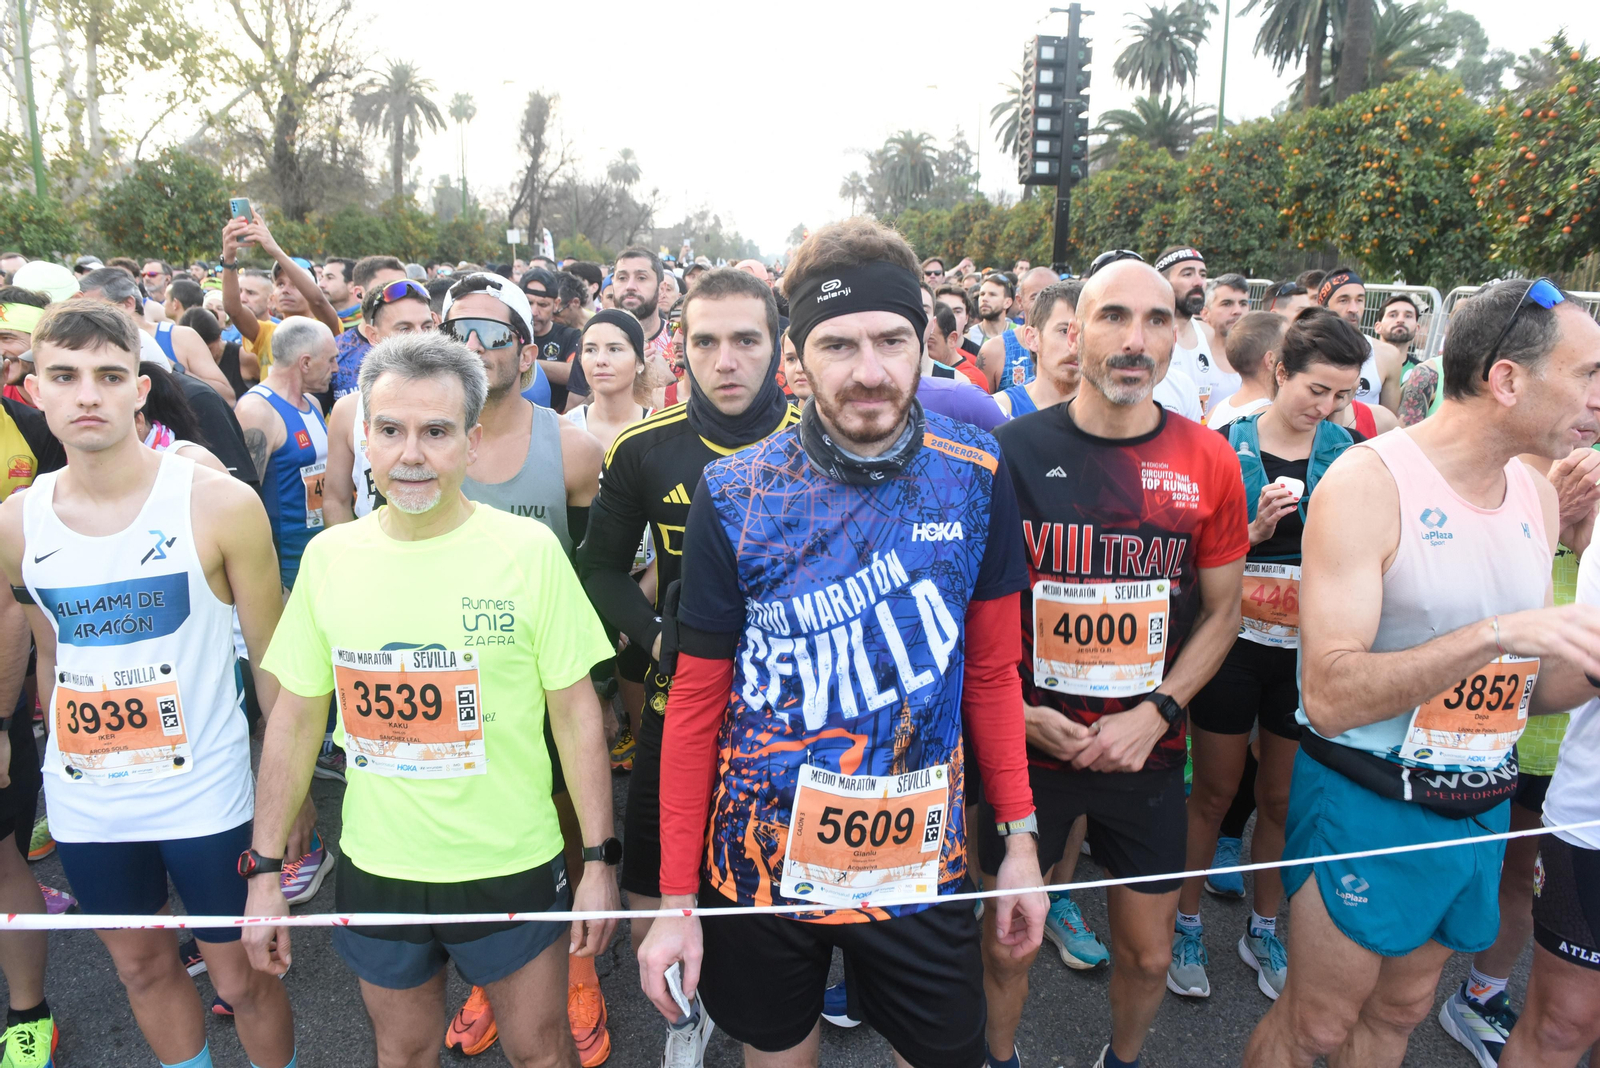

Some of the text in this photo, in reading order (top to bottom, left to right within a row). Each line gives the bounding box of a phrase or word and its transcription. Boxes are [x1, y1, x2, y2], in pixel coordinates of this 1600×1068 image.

[816, 286, 851, 303] Kalenji
[1141, 468, 1174, 479] CIRCUITO
[1141, 477, 1161, 490] TOP
[911, 521, 964, 542] HOKA
[1421, 530, 1453, 540] LaPlaza
[1023, 520, 1187, 577] VIII TRAIL
[792, 548, 910, 634] MARATÓN
[1042, 584, 1152, 600] MEDIO MARATÓN SEVILLA
[1249, 584, 1300, 613] 446
[57, 591, 165, 618] ALHAMA DE
[461, 597, 515, 611] Runners
[73, 613, 154, 639] ARAGÓN
[1053, 612, 1138, 646] 4000
[464, 635, 516, 646] ZAFRA
[337, 649, 457, 669] MEDIO MARATÓN SEVILLA
[113, 666, 156, 687] SEVILLA
[353, 680, 443, 721] 3539
[1443, 673, 1519, 711] 3852
[66, 698, 148, 734] 3938
[388, 721, 409, 729] KAKU
[98, 733, 115, 741] IKER
[379, 734, 405, 743] SANCHEZ
[107, 770, 129, 779] HOKA
[396, 763, 418, 772] HOKA
[1421, 760, 1518, 790] WONG
[810, 769, 931, 793] MEDIO MARATÓN SEVILLA
[796, 818, 805, 837] CAJÓN
[816, 806, 915, 848] 5609
[847, 864, 878, 872] Acquaviva
[1336, 888, 1369, 903] LaPlaza
[1558, 941, 1600, 964] ATLE
